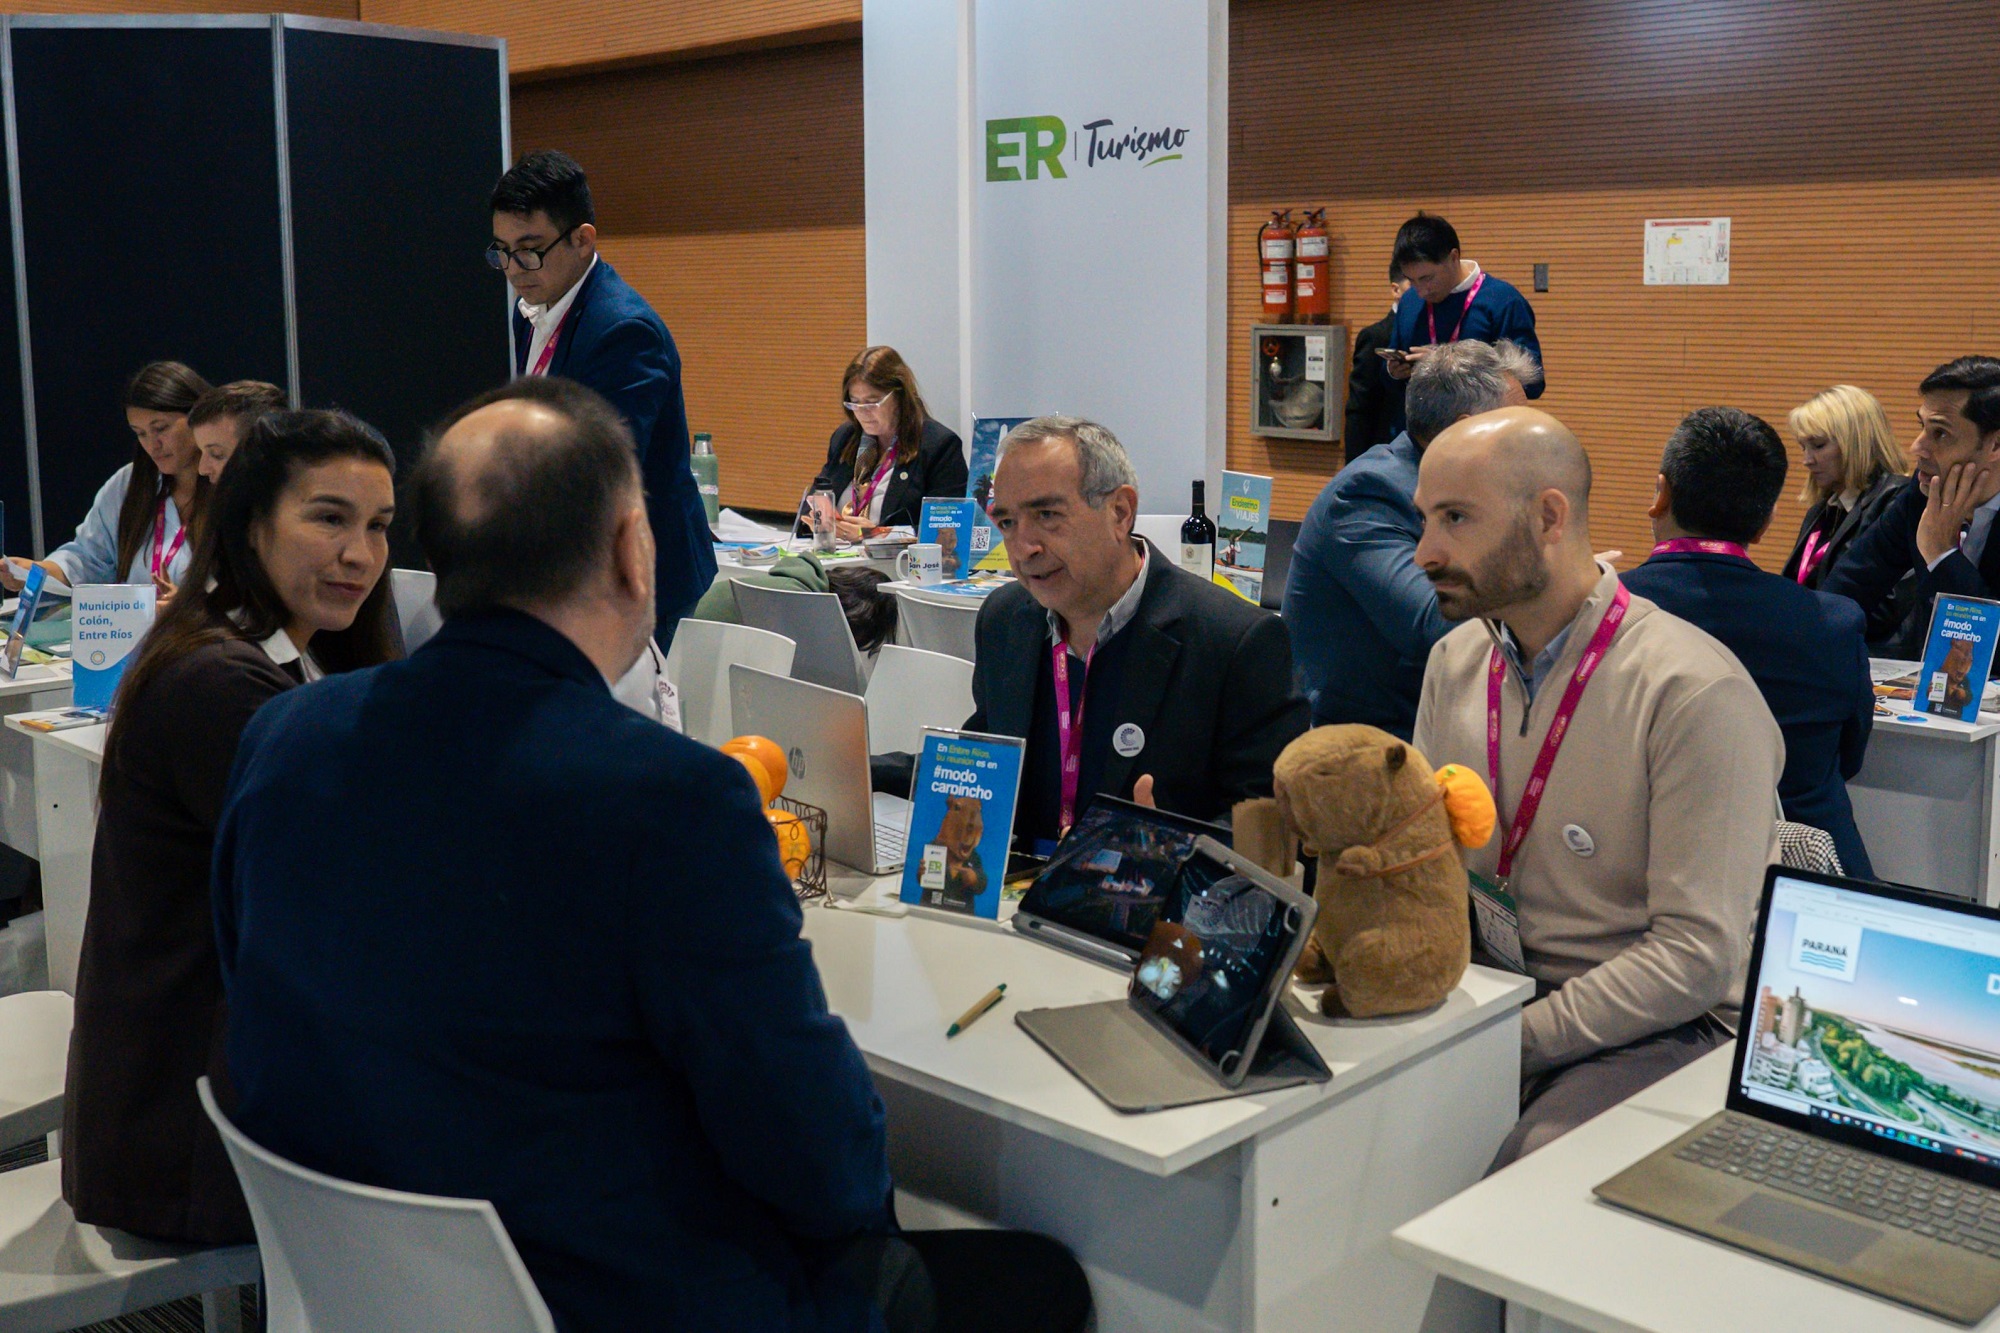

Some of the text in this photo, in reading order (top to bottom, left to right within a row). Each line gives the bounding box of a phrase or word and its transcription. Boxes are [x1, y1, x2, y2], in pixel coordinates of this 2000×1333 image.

[986, 115, 1190, 182] ER Turismo
[79, 600, 146, 613] Municipio de
[79, 615, 113, 626] Colón,
[1943, 618, 1972, 632] #modo
[79, 628, 133, 640] Entre Ríos
[1941, 629, 1982, 643] carpincho
[937, 743, 948, 753] En
[976, 760, 986, 768] es
[987, 761, 998, 770] en
[933, 764, 978, 784] #modo
[931, 781, 993, 800] carpincho
[1801, 938, 1849, 958] PARANÁ
